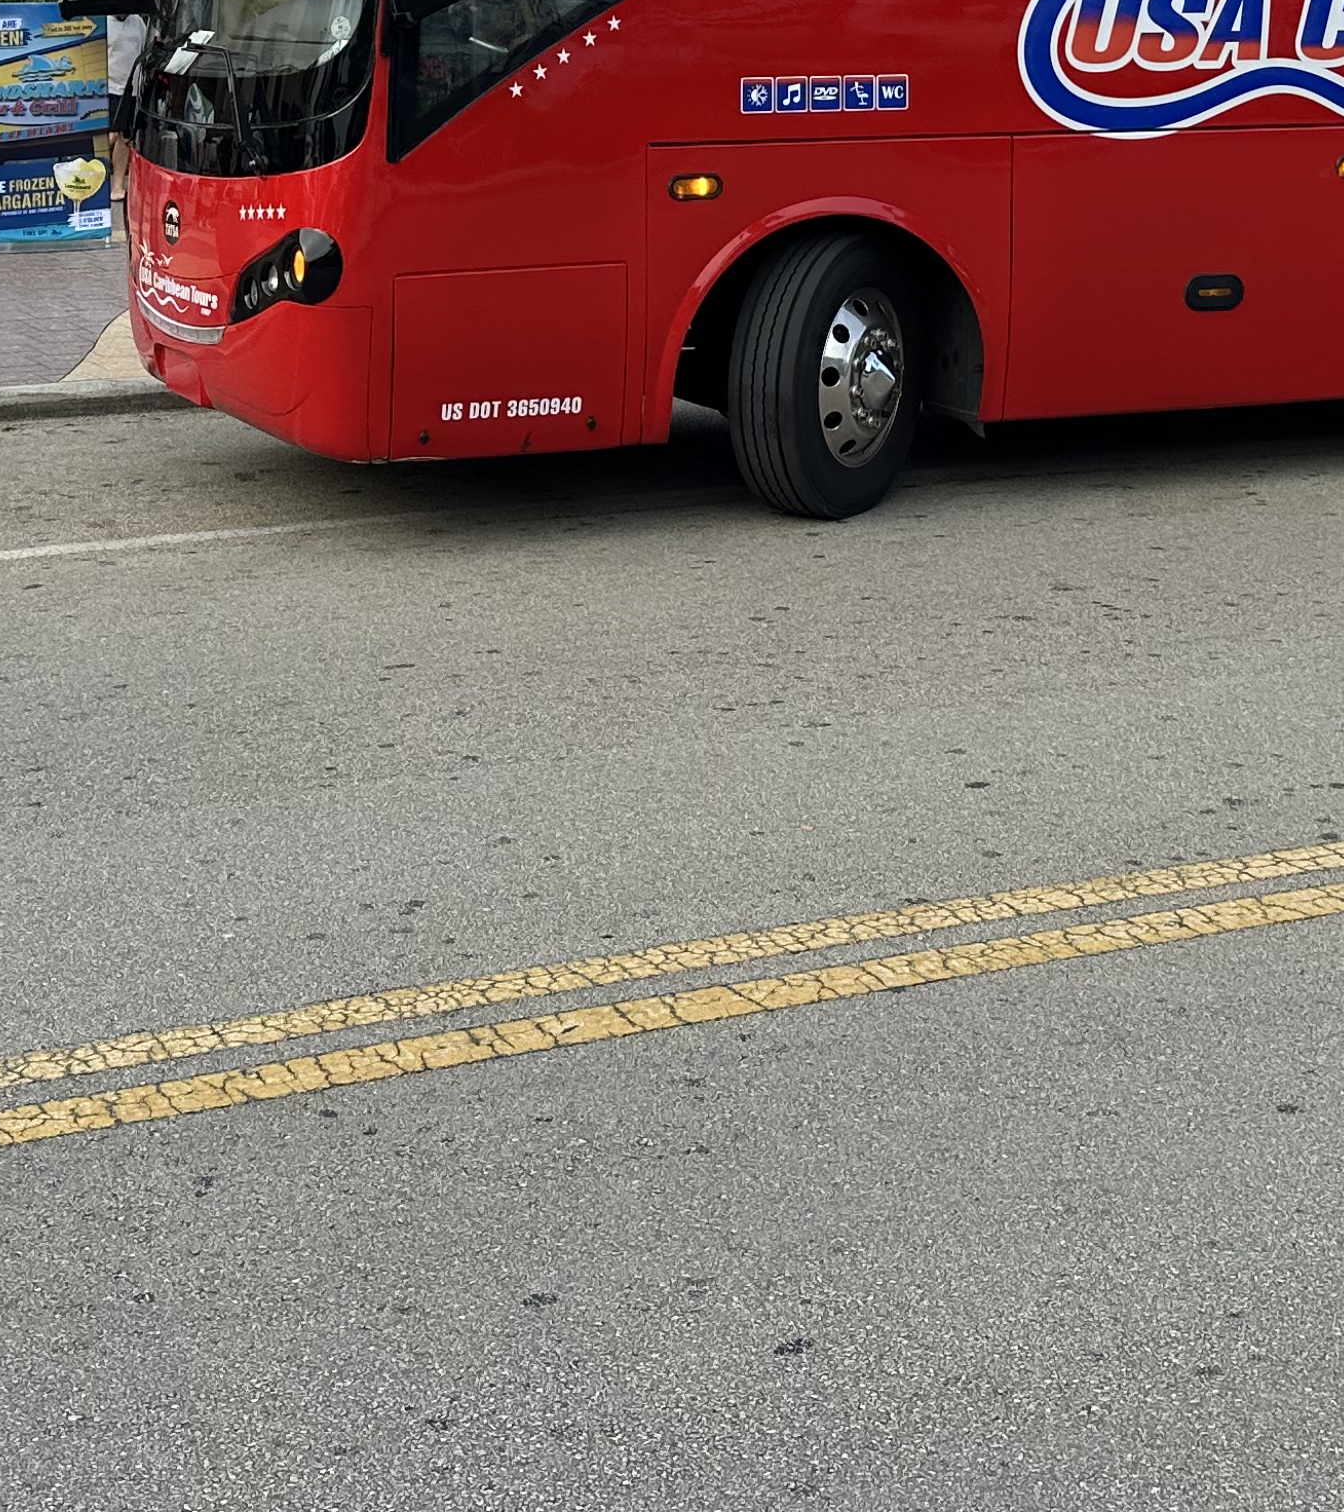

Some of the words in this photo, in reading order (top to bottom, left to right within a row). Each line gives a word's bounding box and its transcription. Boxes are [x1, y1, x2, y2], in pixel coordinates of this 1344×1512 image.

[1, 19, 18, 29] ARE
[813, 87, 838, 95] DVD
[881, 85, 904, 99] WC
[29, 99, 77, 116] Grill
[26, 122, 75, 138] MIAMI
[9, 177, 55, 193] FROZEN
[153, 272, 191, 301] Caribbean
[190, 285, 219, 309] Tours
[441, 403, 463, 421] US
[469, 401, 501, 419] DOT
[506, 396, 583, 417] 3650940
